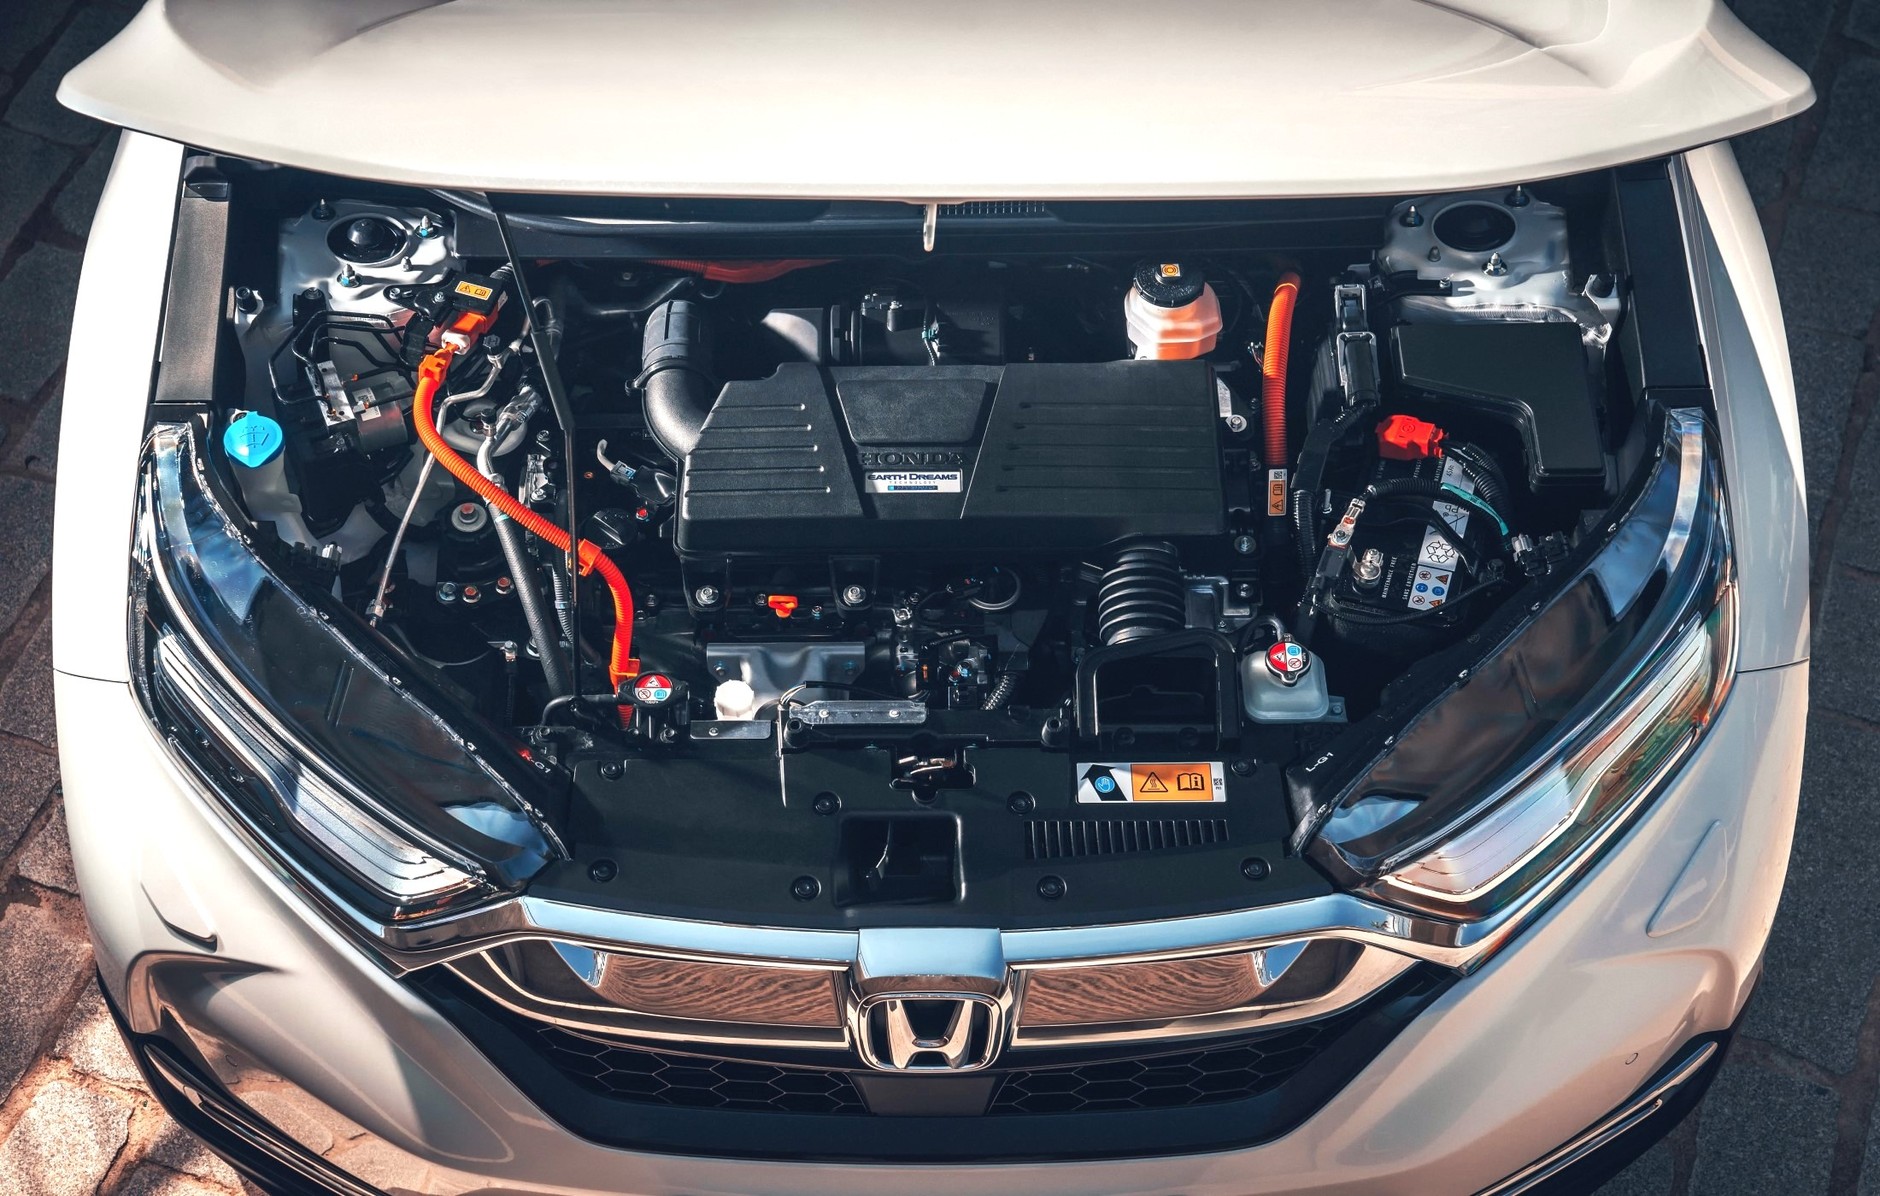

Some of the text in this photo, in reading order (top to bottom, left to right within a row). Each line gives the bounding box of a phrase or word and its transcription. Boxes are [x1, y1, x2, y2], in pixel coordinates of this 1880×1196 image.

[861, 452, 965, 465] HONDA
[1445, 504, 1459, 514] Pb
[1381, 556, 1398, 599] MAINTENANCE FREE
[1305, 752, 1334, 772] L-G1
